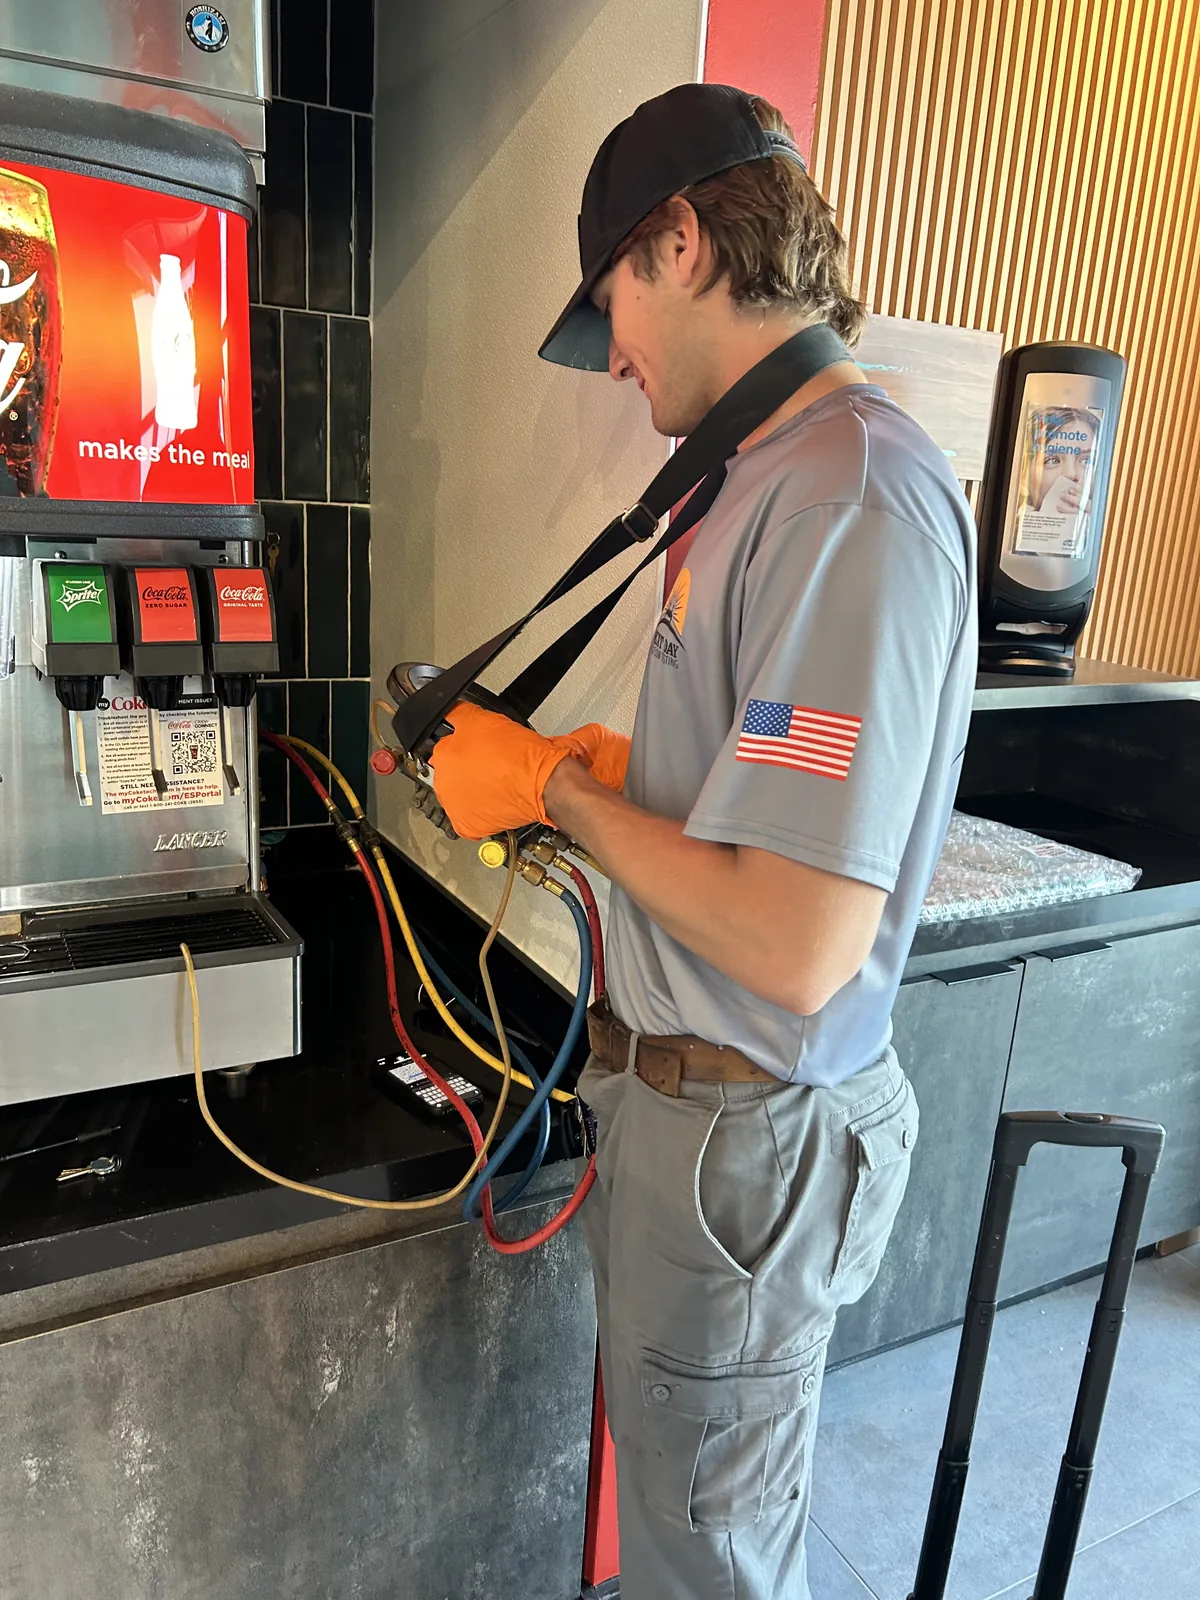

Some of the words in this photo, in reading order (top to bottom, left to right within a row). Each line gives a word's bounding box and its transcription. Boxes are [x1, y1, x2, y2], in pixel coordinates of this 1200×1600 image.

[78, 439, 161, 463] makes
[168, 444, 206, 465] the
[212, 450, 250, 469] meal
[63, 589, 98, 603] Sprite
[142, 586, 189, 601] Coca-Cola
[220, 585, 265, 601] Coca-Cola
[111, 696, 148, 711] Cok
[165, 778, 205, 786] SSISTANCE?
[121, 789, 222, 805] myCokem/ESPortal
[153, 828, 229, 853] LANCER
